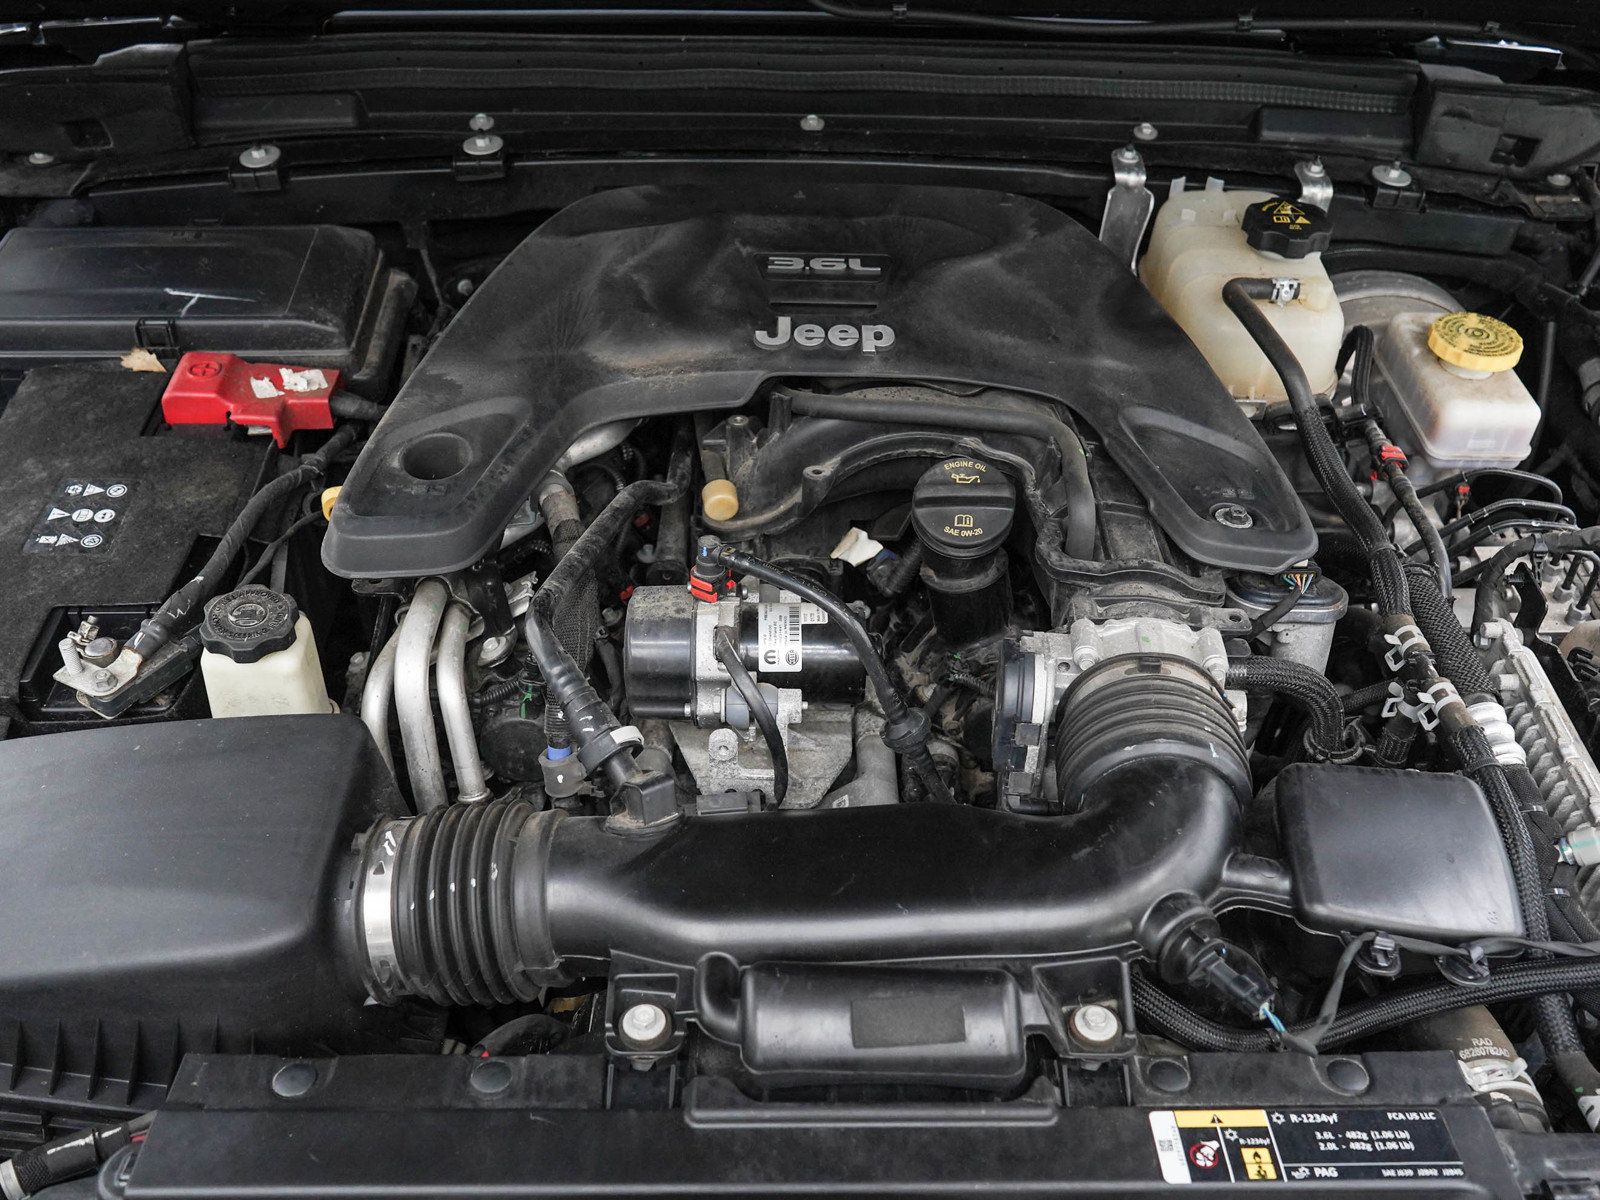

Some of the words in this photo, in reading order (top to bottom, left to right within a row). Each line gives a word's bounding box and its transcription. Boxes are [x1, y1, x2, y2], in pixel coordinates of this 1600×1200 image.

[767, 256, 882, 274] 3.6L
[754, 316, 896, 353] Jeep
[943, 461, 973, 470] ENGINE
[974, 463, 988, 472] OIL
[943, 526, 959, 536] SAE
[960, 527, 984, 537] 0W-20
[1471, 1037, 1493, 1046] RAD
[1289, 1112, 1339, 1124] R-1234yf
[1387, 1111, 1408, 1121] FCA
[1408, 1112, 1420, 1121] US
[1420, 1111, 1437, 1121] LLC
[1314, 1131, 1336, 1140] 3.6L
[1395, 1130, 1411, 1141] Lb)
[1318, 1142, 1340, 1151] 2.0L
[1399, 1141, 1416, 1152] Lb)
[1313, 1166, 1339, 1178] PAG
